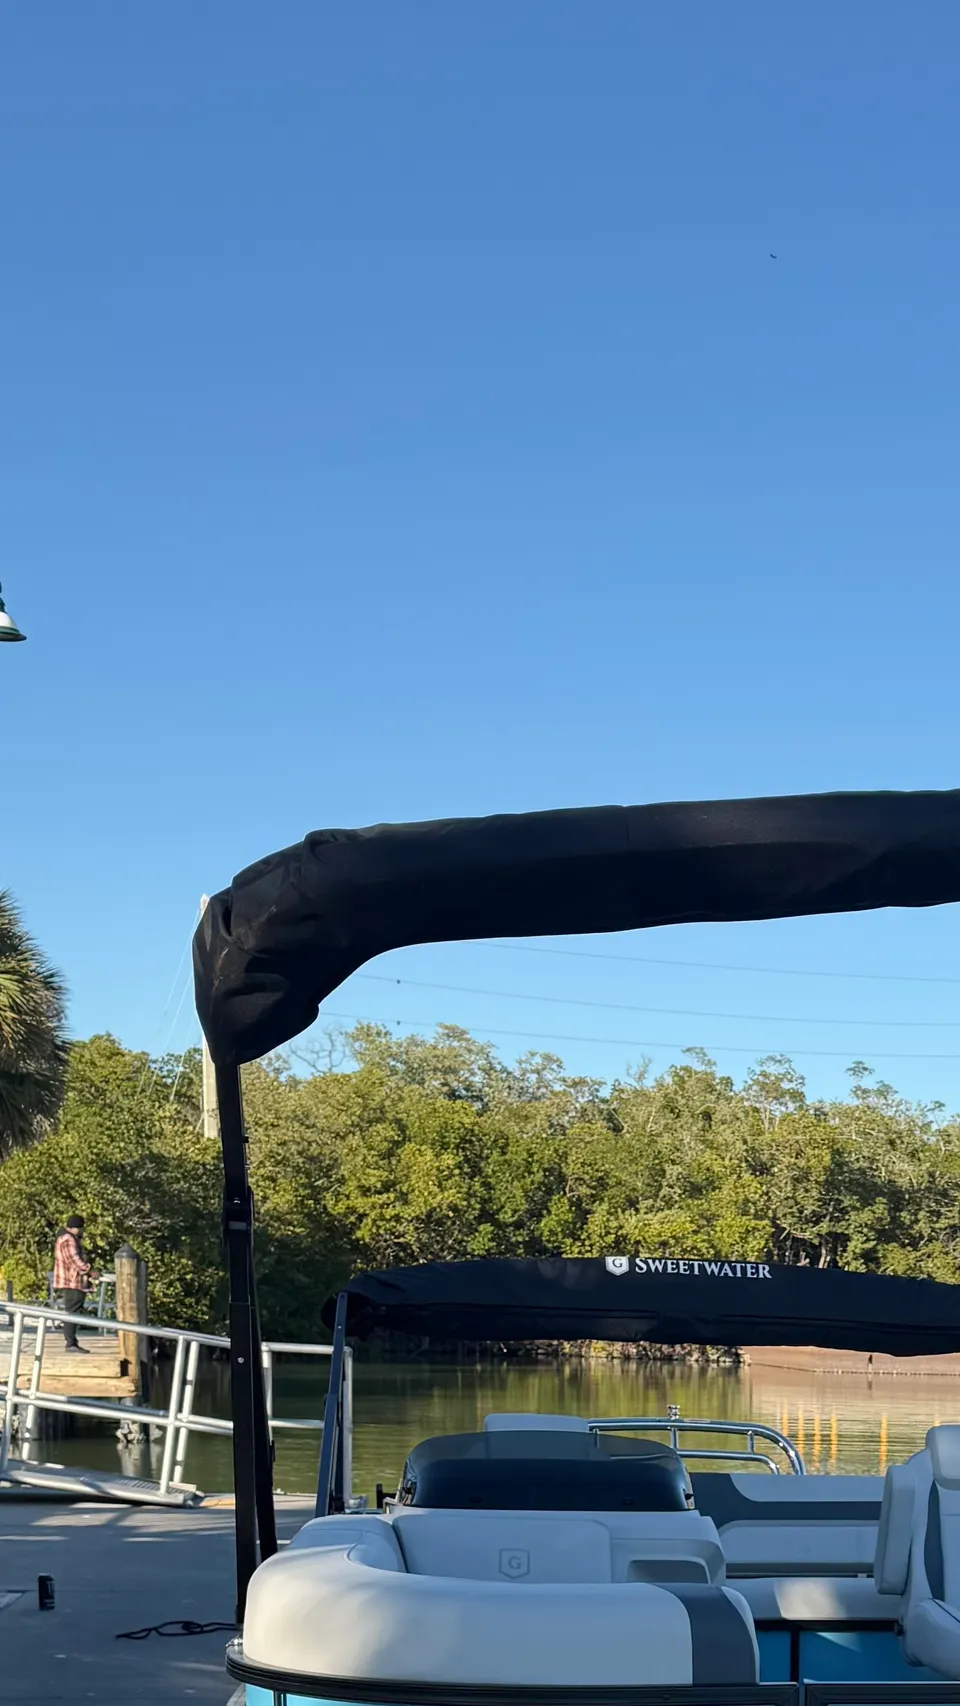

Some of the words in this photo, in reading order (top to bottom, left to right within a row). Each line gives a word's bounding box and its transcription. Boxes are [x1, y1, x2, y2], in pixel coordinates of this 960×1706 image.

[612, 1258, 623, 1268] G
[635, 1257, 772, 1279] SWEETWATER
[508, 1556, 522, 1570] G
